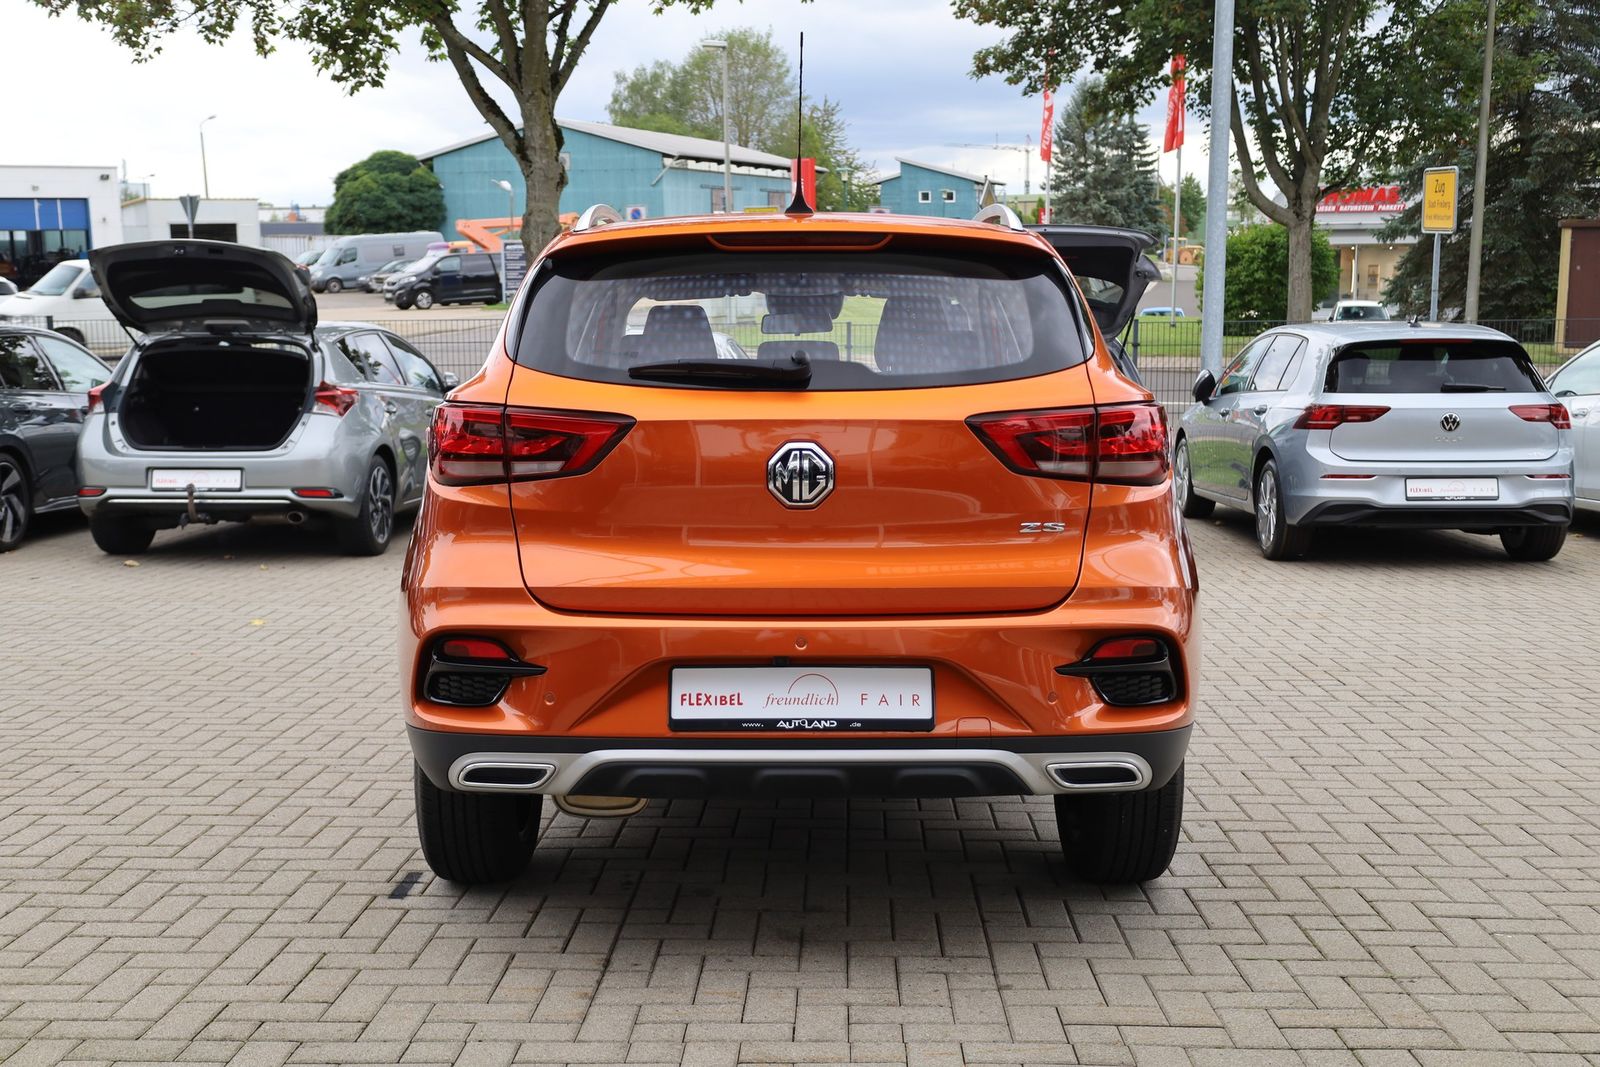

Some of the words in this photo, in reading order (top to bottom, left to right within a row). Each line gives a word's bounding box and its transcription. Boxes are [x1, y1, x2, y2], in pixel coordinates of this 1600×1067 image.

[1320, 187, 1400, 204] HOMAS
[1434, 179, 1445, 196] Zug
[774, 450, 827, 502] MG
[1019, 522, 1066, 533] ZS
[680, 692, 743, 706] FLEXIBEL
[762, 692, 838, 709] freundlich
[860, 693, 921, 706] FAIR
